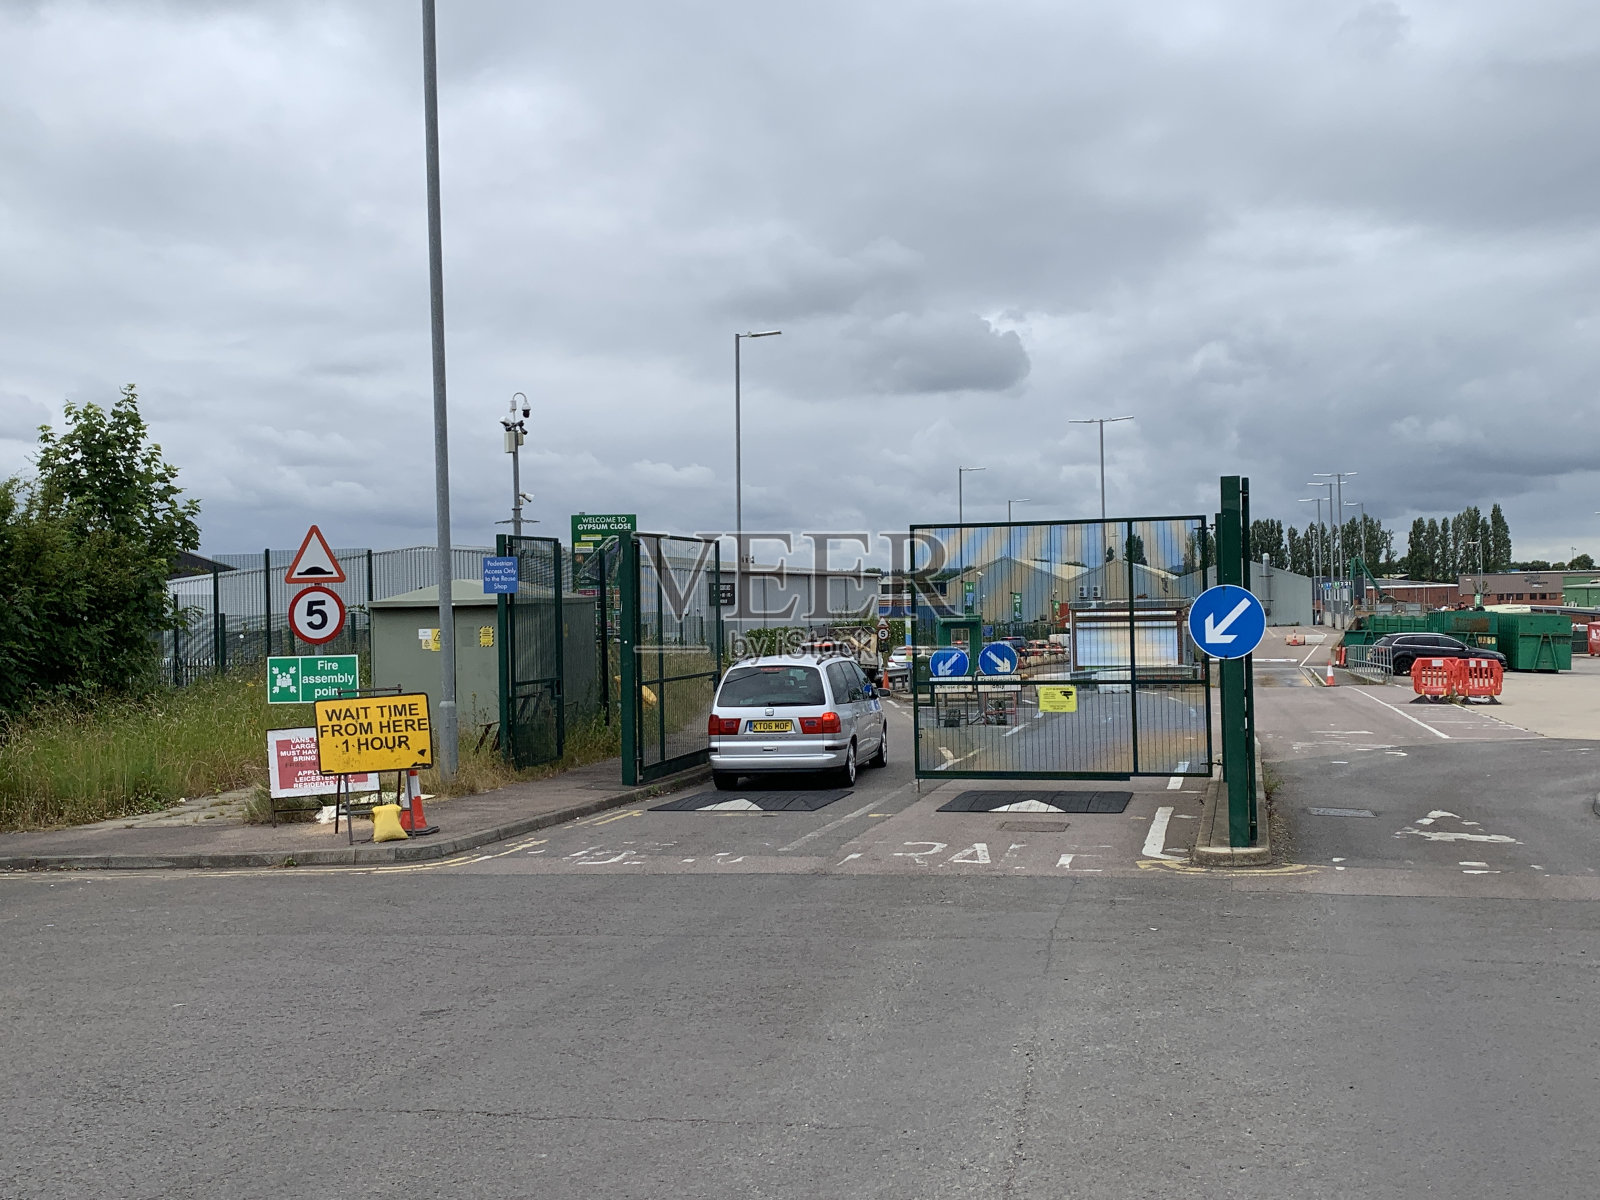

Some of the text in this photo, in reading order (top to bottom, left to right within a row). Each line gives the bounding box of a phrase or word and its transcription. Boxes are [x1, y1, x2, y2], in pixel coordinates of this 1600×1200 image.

[581, 516, 616, 524] WELCOME
[503, 567, 517, 575] Only
[493, 582, 508, 590] Shop
[306, 600, 328, 630] 5
[880, 630, 886, 638] 5
[317, 660, 339, 670] Fire
[302, 672, 354, 685] assembly
[325, 703, 420, 721] WAIT TIME
[320, 718, 429, 738] FROM HERE
[342, 735, 410, 752] 1 HOUR
[294, 774, 336, 783] LEICESTER
[293, 780, 334, 789] RESIDENTS
